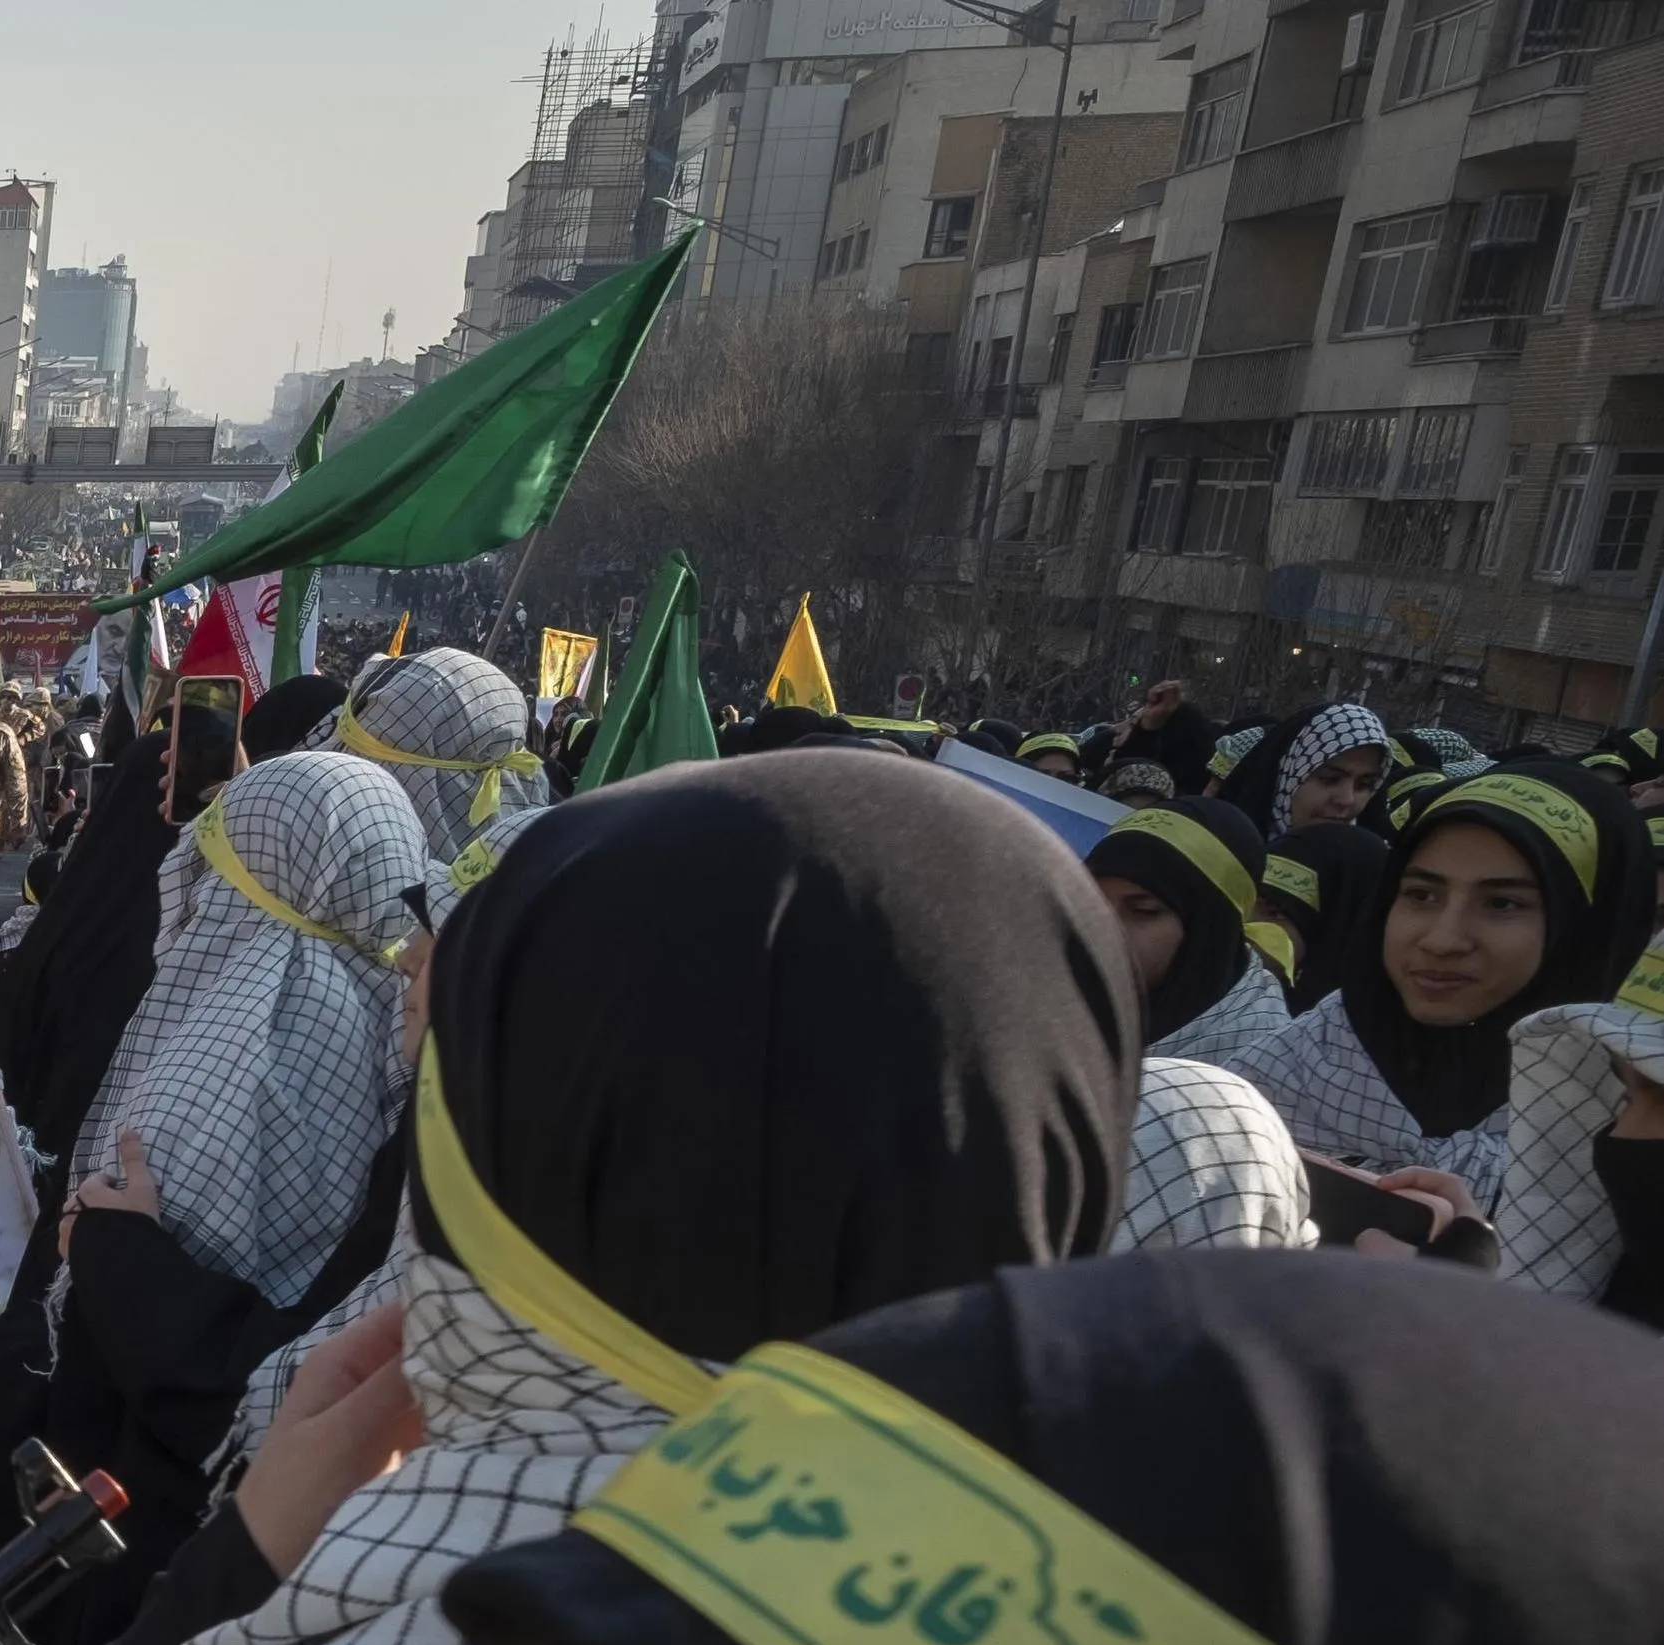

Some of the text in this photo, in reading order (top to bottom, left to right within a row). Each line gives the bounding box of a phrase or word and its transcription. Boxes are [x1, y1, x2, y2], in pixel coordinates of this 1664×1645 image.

[0, 611, 78, 625] راهیان قدس
[701, 1456, 851, 1544] حزب
